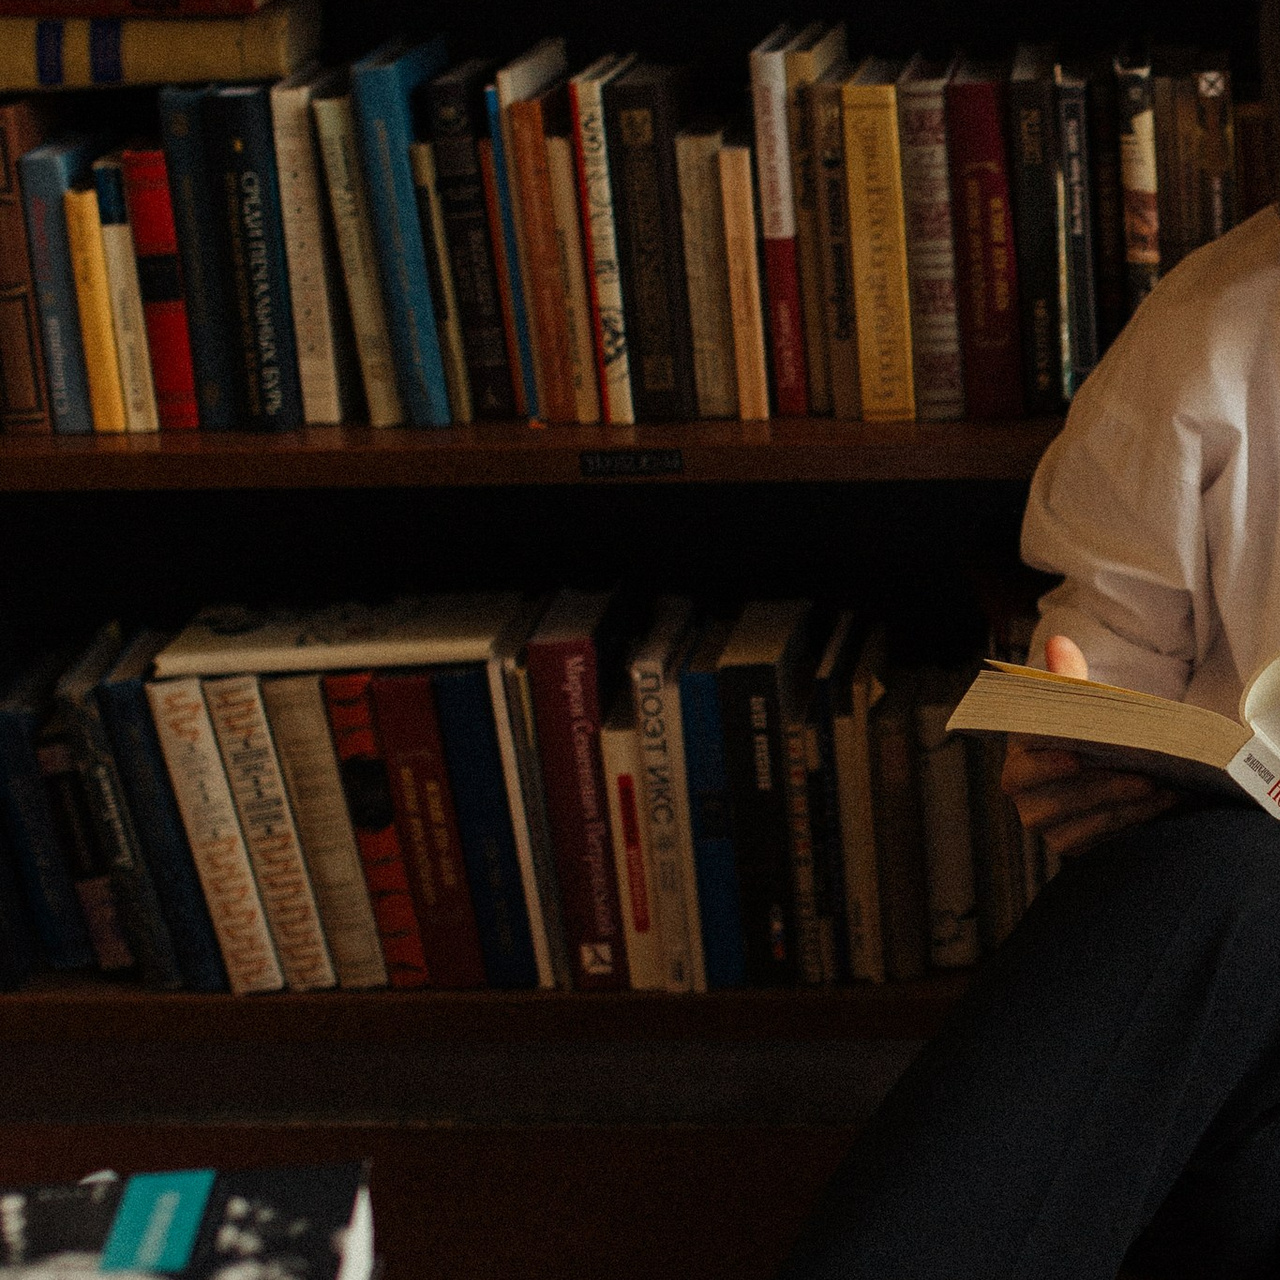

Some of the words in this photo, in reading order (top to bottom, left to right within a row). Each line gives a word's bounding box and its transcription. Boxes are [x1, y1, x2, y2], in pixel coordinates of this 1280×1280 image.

[242, 171, 265, 238] СРЕДИ
[260, 365, 283, 416] БУРЬ
[561, 655, 587, 718] Мирон
[637, 670, 667, 754] ПОЭТ
[646, 765, 673, 825] ИКС
